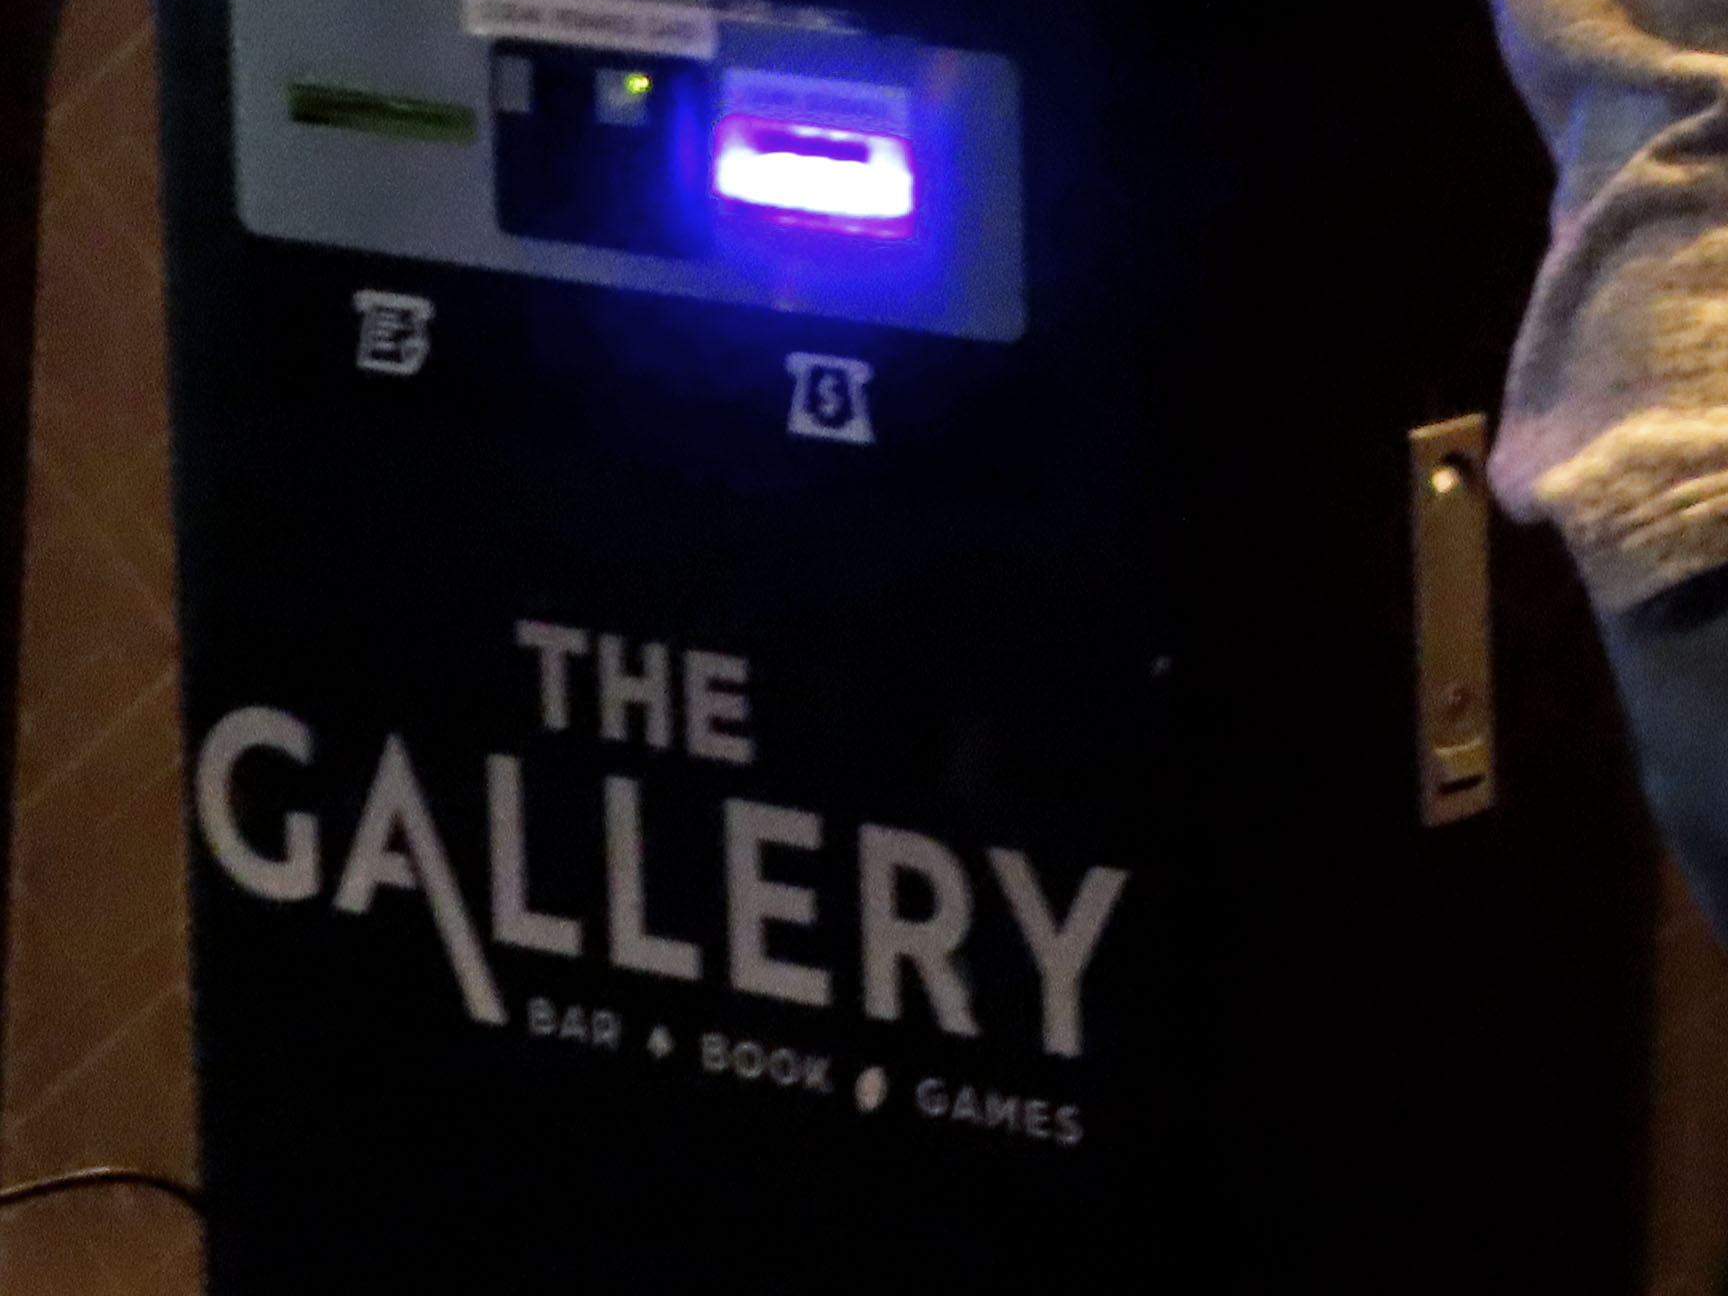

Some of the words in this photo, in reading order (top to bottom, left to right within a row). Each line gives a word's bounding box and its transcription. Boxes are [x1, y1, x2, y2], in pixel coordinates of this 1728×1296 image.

[515, 617, 757, 766] THE
[197, 704, 1131, 1060] GALLERY
[527, 996, 620, 1051] BAR
[699, 1031, 833, 1097] BOOK
[914, 1076, 1086, 1148] GAMES
